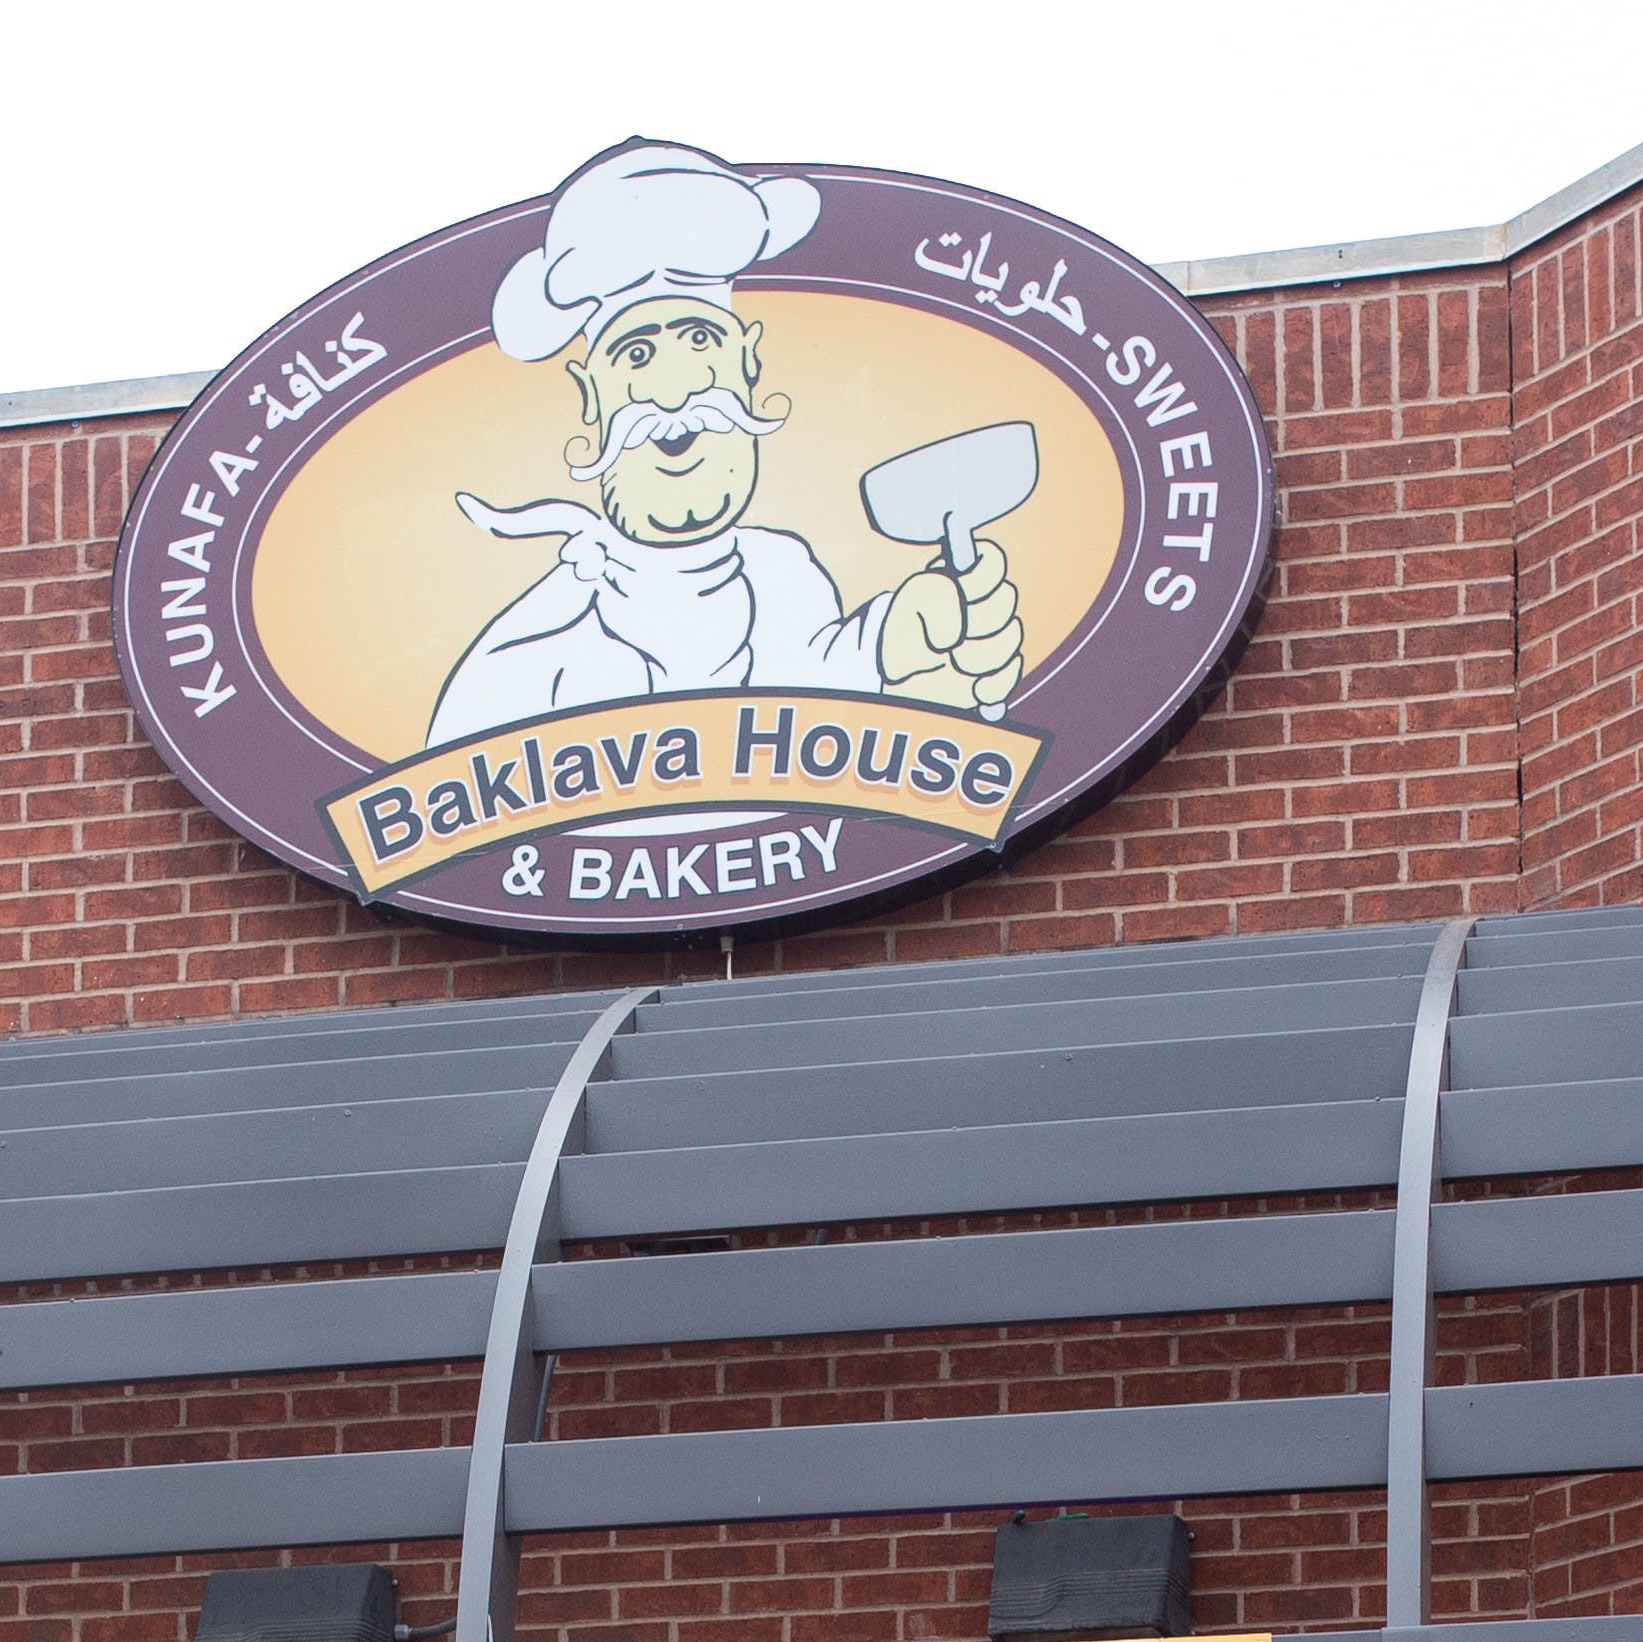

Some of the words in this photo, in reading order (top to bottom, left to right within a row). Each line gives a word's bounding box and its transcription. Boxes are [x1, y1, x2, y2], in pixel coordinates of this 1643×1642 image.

[359, 727, 700, 864] Baklava
[733, 706, 1015, 807] House
[501, 844, 545, 897] &
[569, 817, 843, 900] BAKERY
